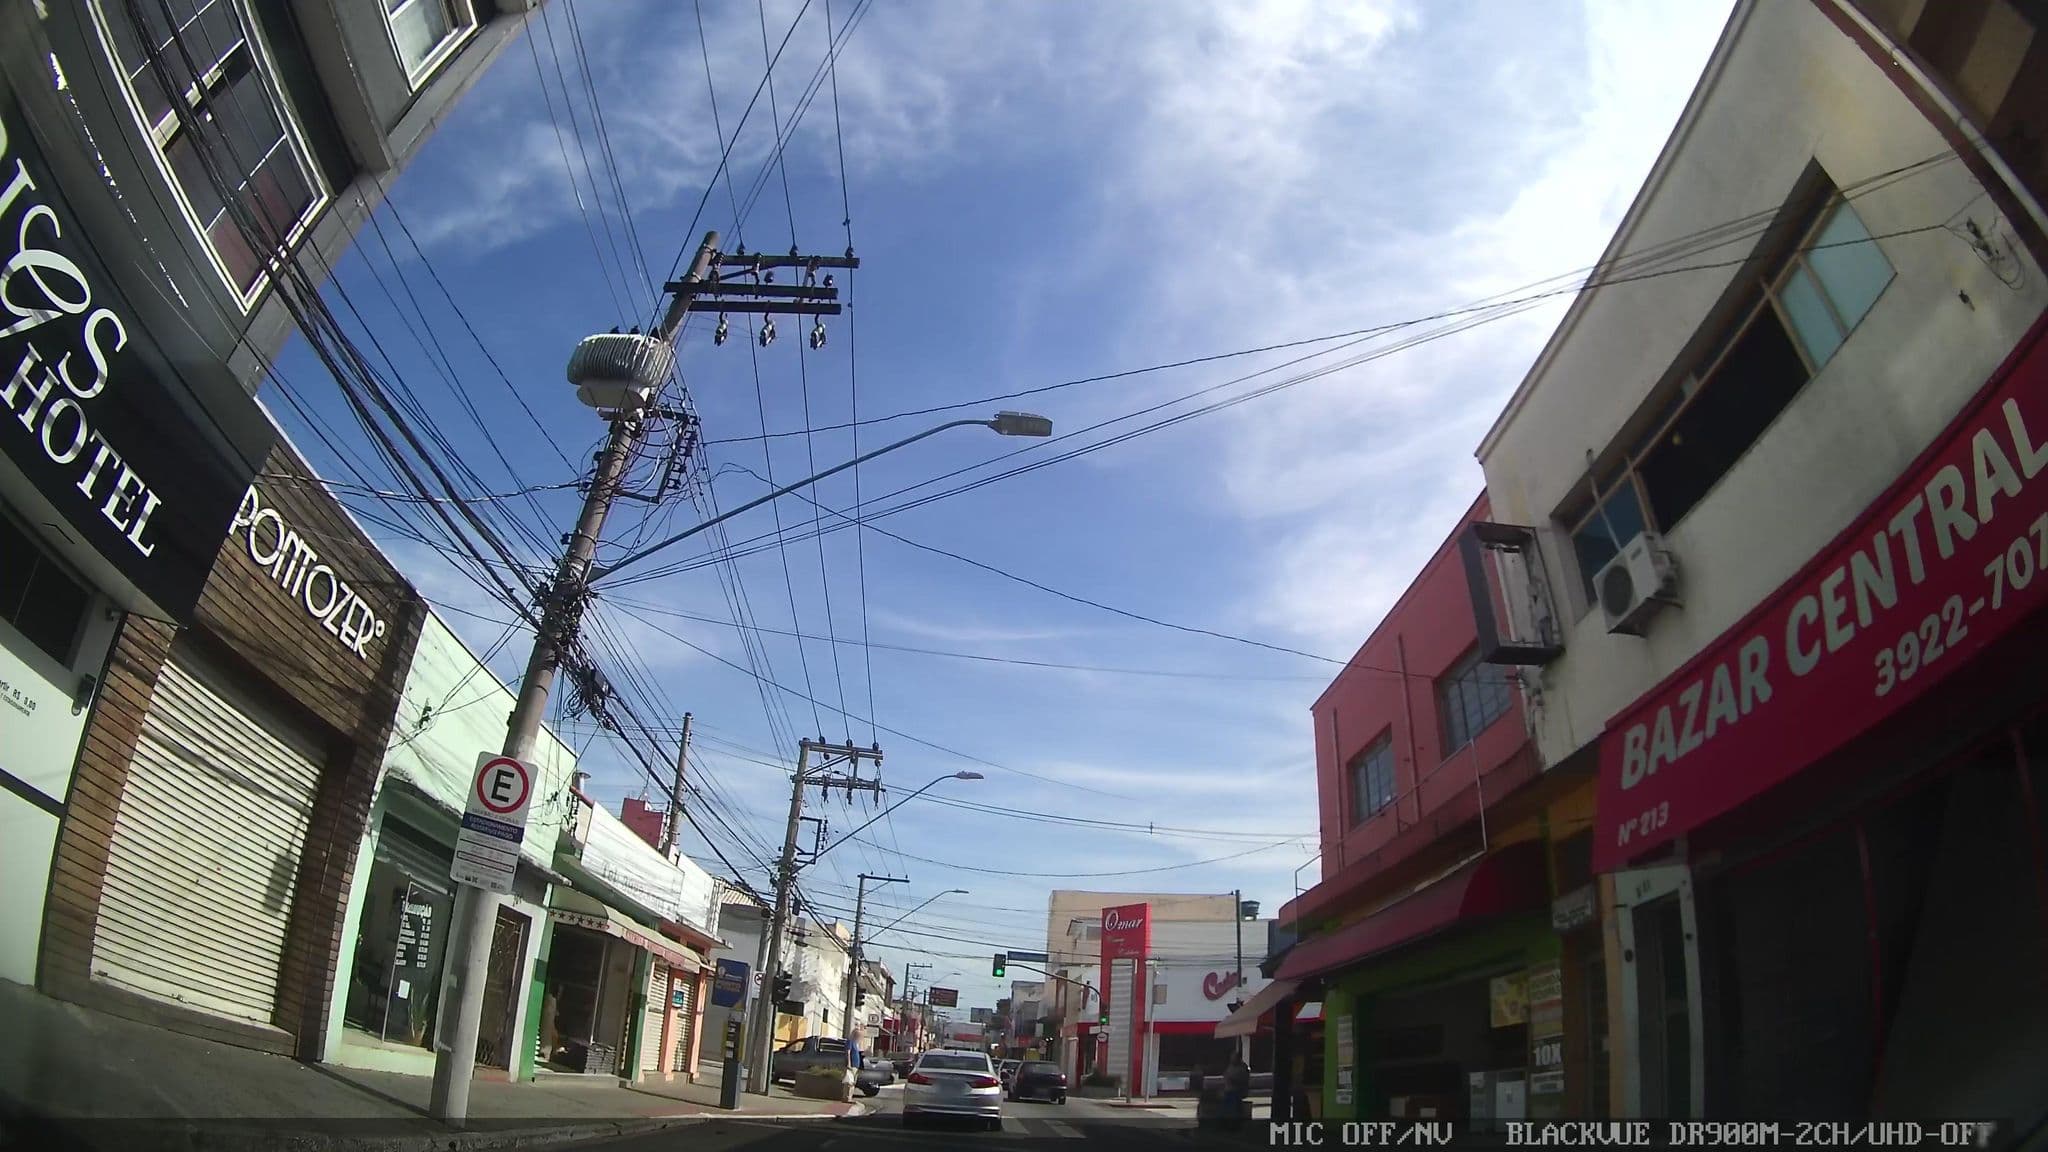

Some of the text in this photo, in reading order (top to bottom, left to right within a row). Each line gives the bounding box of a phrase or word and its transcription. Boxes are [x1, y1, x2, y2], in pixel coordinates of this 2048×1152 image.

[0, 342, 161, 557] HOTEL
[1621, 397, 2048, 790] BAZAR CENTRAL
[491, 768, 515, 803] E
[1640, 801, 1669, 837] 213
[1105, 910, 1143, 931] Omar
